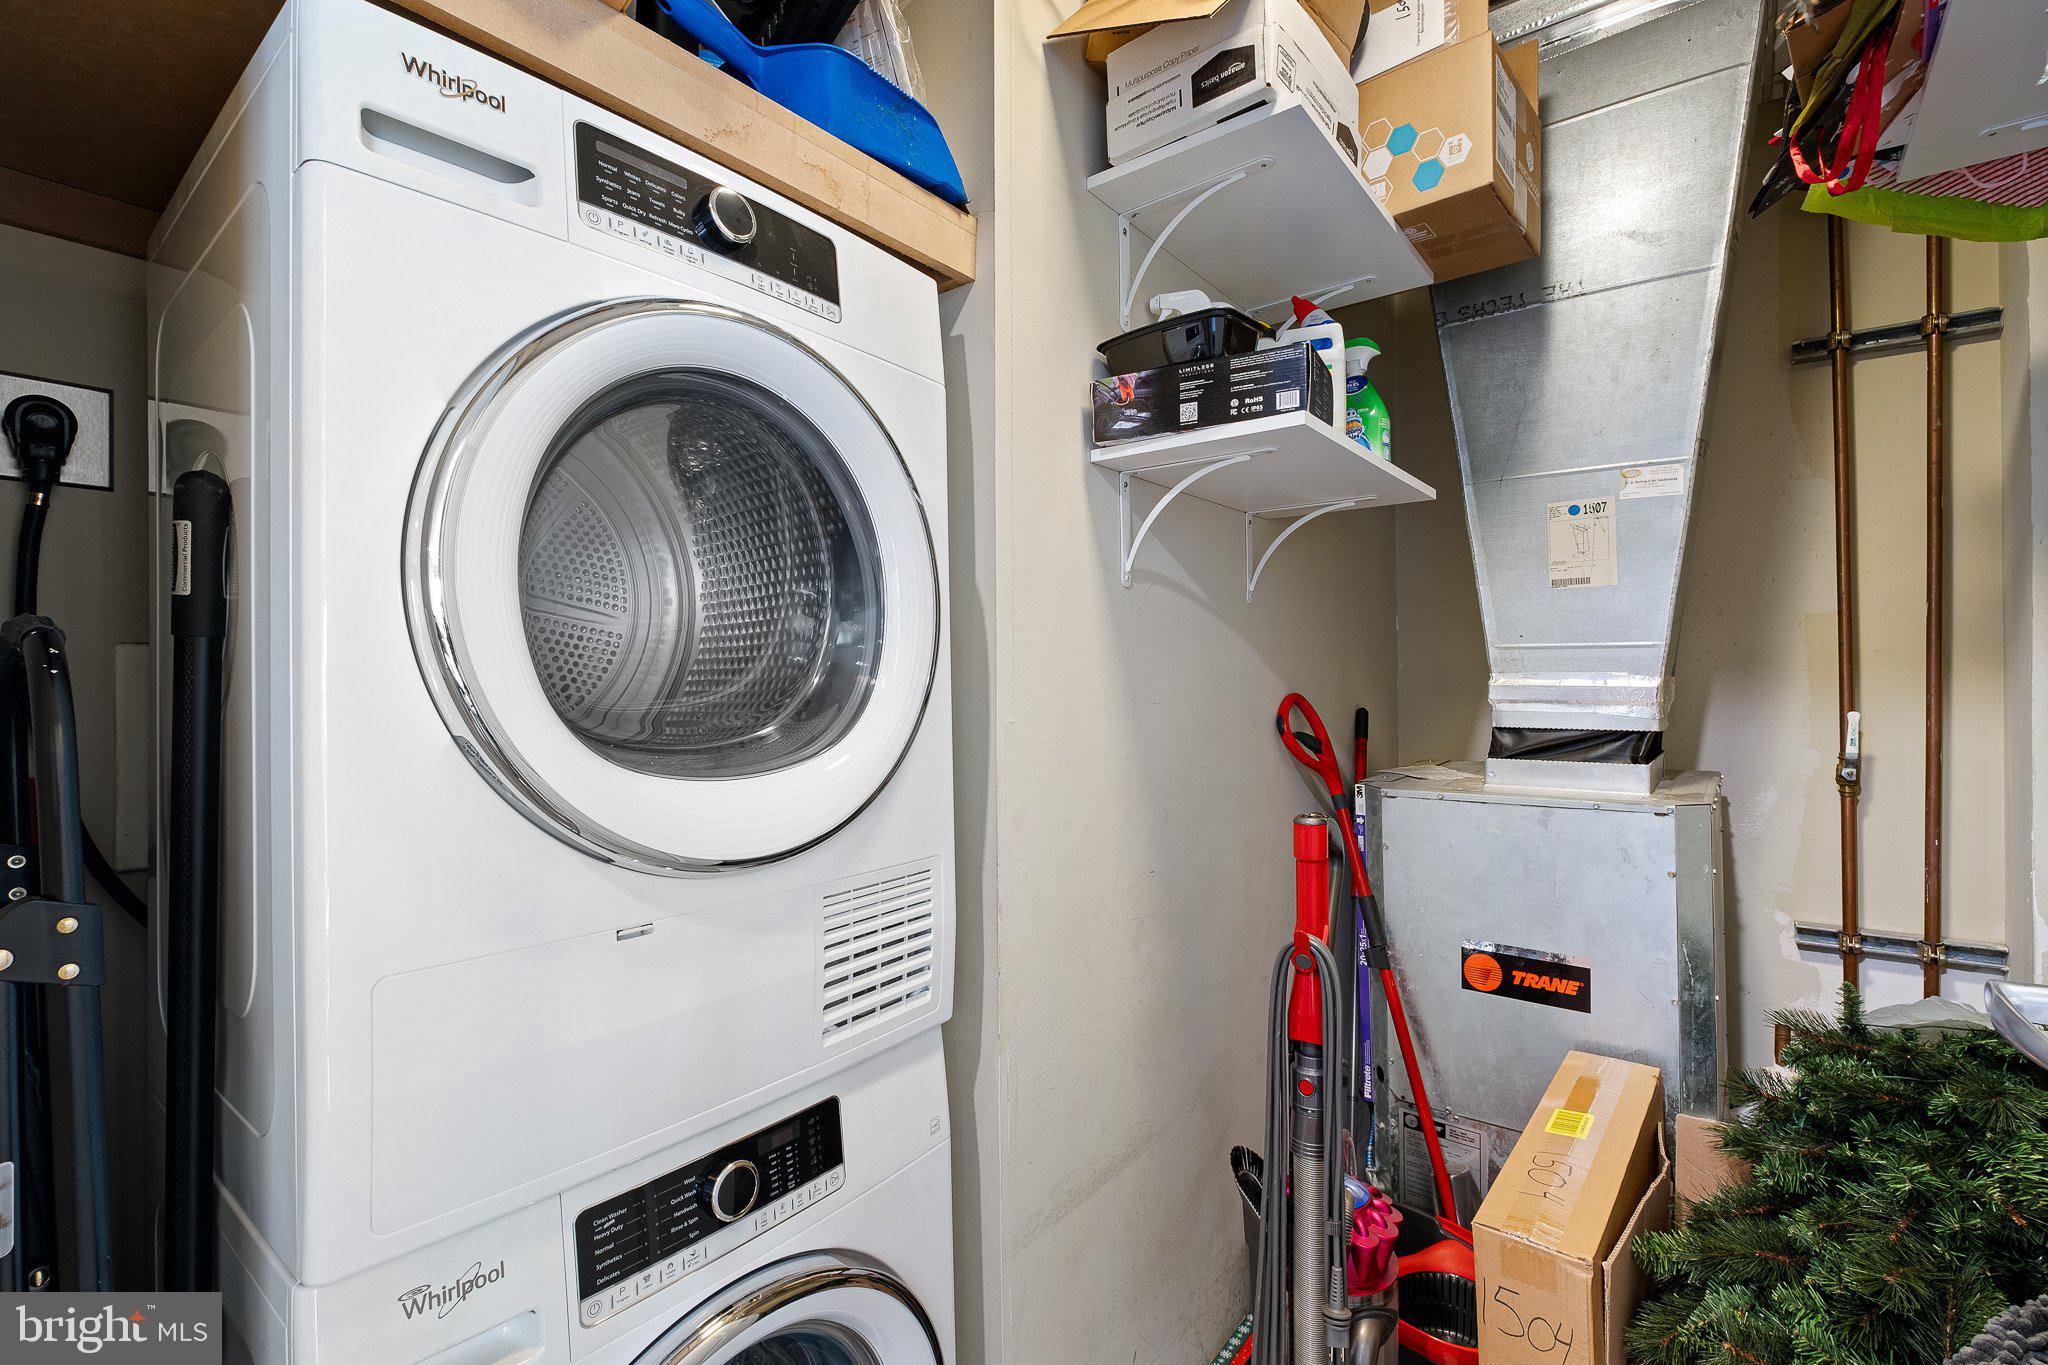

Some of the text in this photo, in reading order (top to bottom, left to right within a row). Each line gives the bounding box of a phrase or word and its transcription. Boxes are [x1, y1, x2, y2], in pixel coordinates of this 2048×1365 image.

[1124, 45, 1200, 89] Multipurpose Copy Paper
[401, 51, 506, 113] Whirlpool
[1201, 62, 1246, 89] amazon basics
[598, 160, 618, 172] Normal
[596, 175, 622, 190] Synthetics
[624, 171, 641, 182] Whites
[627, 189, 641, 198] Jeans
[645, 180, 667, 193] Delicates
[601, 194, 618, 205] Sports
[649, 197, 666, 208] Towels
[671, 191, 686, 201] Colors
[622, 202, 647, 217] Quick Dry
[673, 207, 686, 217] Bulky
[649, 213, 668, 224] Refresh
[1179, 363, 1214, 373] LIMITLESS
[181, 523, 189, 552] Products
[1356, 785, 1364, 799] 3M
[1512, 970, 1581, 996] TRANE
[1363, 1065, 1372, 1100] Filtrete
[683, 1175, 696, 1185] Wool
[671, 1189, 697, 1205] Quick Wash
[593, 1217, 608, 1227] Clean
[608, 1207, 628, 1220] Washer
[673, 1203, 698, 1218] Handwash
[671, 1224, 684, 1234] Rinse
[688, 1216, 699, 1226] Spin
[593, 1230, 610, 1242] Heavy
[611, 1224, 624, 1234] Duty
[689, 1230, 700, 1239] Spin
[594, 1242, 615, 1256] Normal
[595, 1254, 623, 1271] Synthetics
[596, 1270, 621, 1286] Delicates
[400, 1260, 505, 1319] Whirlpool
[1483, 1276, 1574, 1365] 1504
